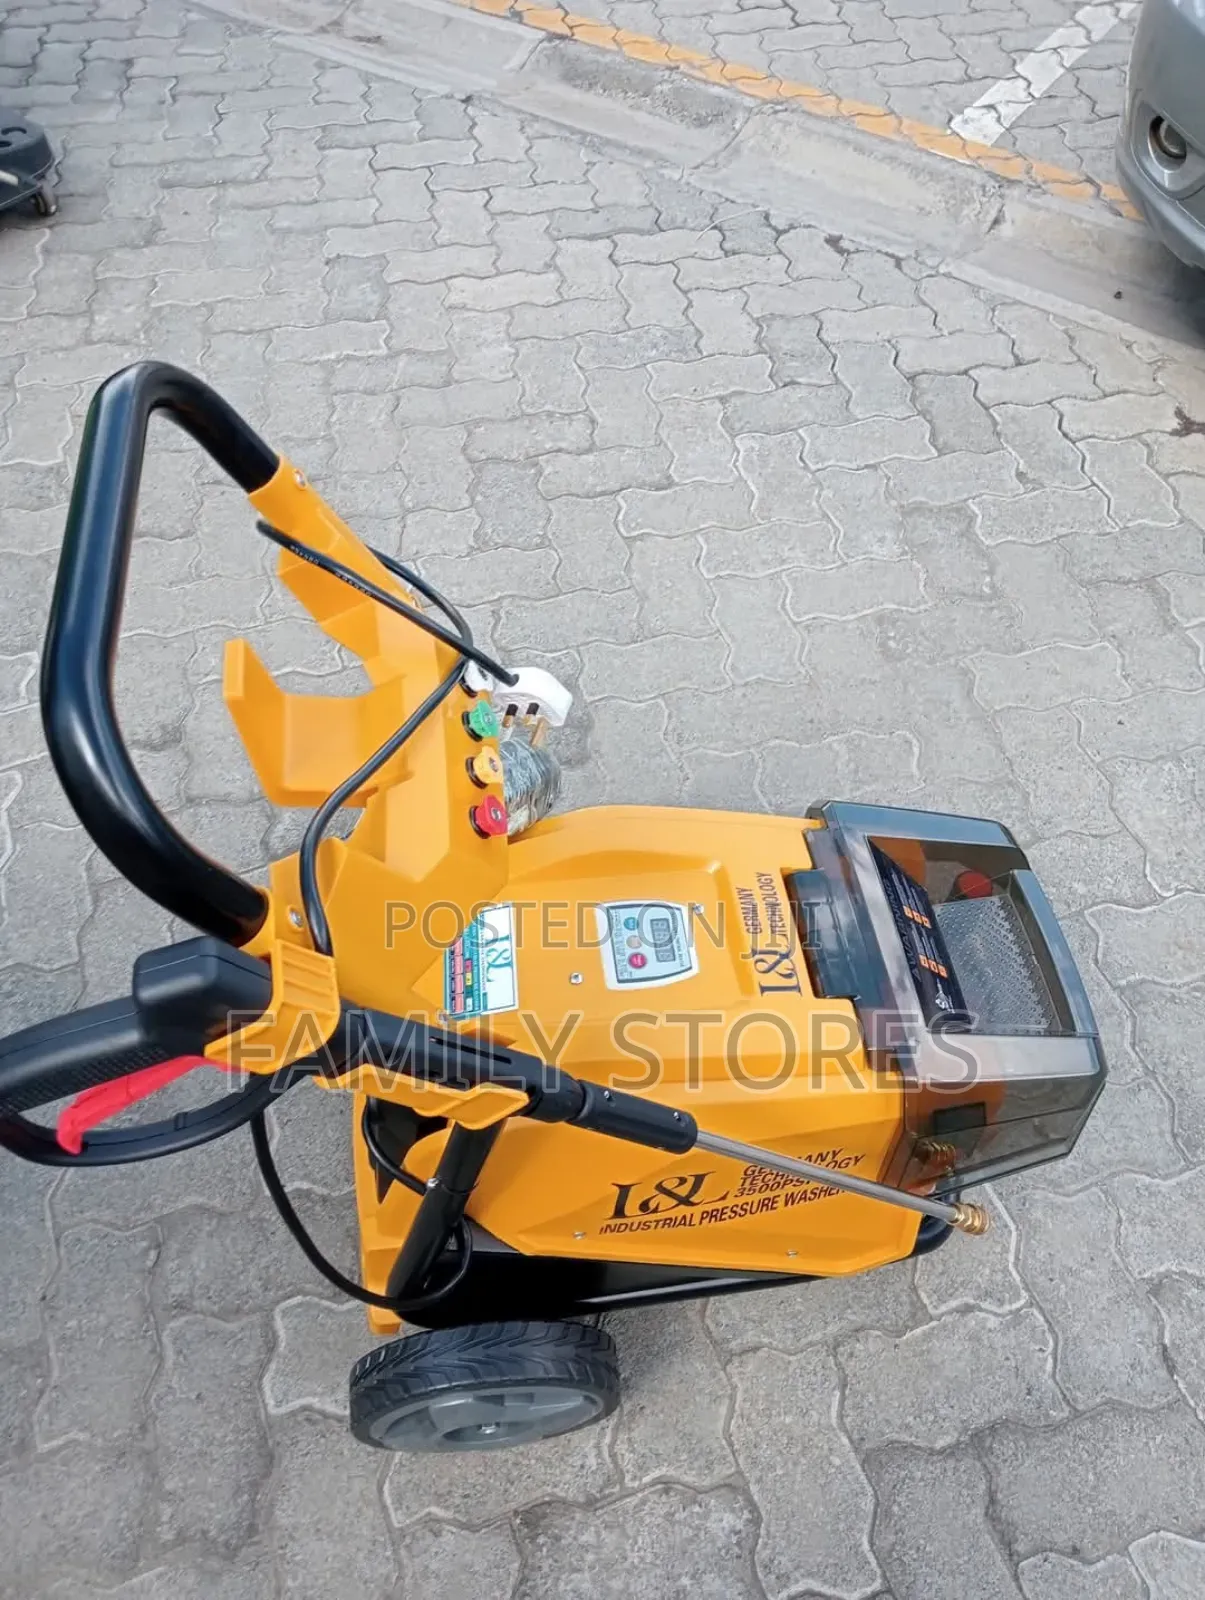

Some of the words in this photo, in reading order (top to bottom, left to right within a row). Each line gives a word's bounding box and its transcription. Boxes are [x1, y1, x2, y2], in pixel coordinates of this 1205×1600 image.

[735, 886, 763, 935] GERMANY
[755, 871, 787, 935] TECHNOLOGY
[599, 1212, 696, 1235] INDUSTRIAL
[699, 1194, 778, 1226] PRESSURE
